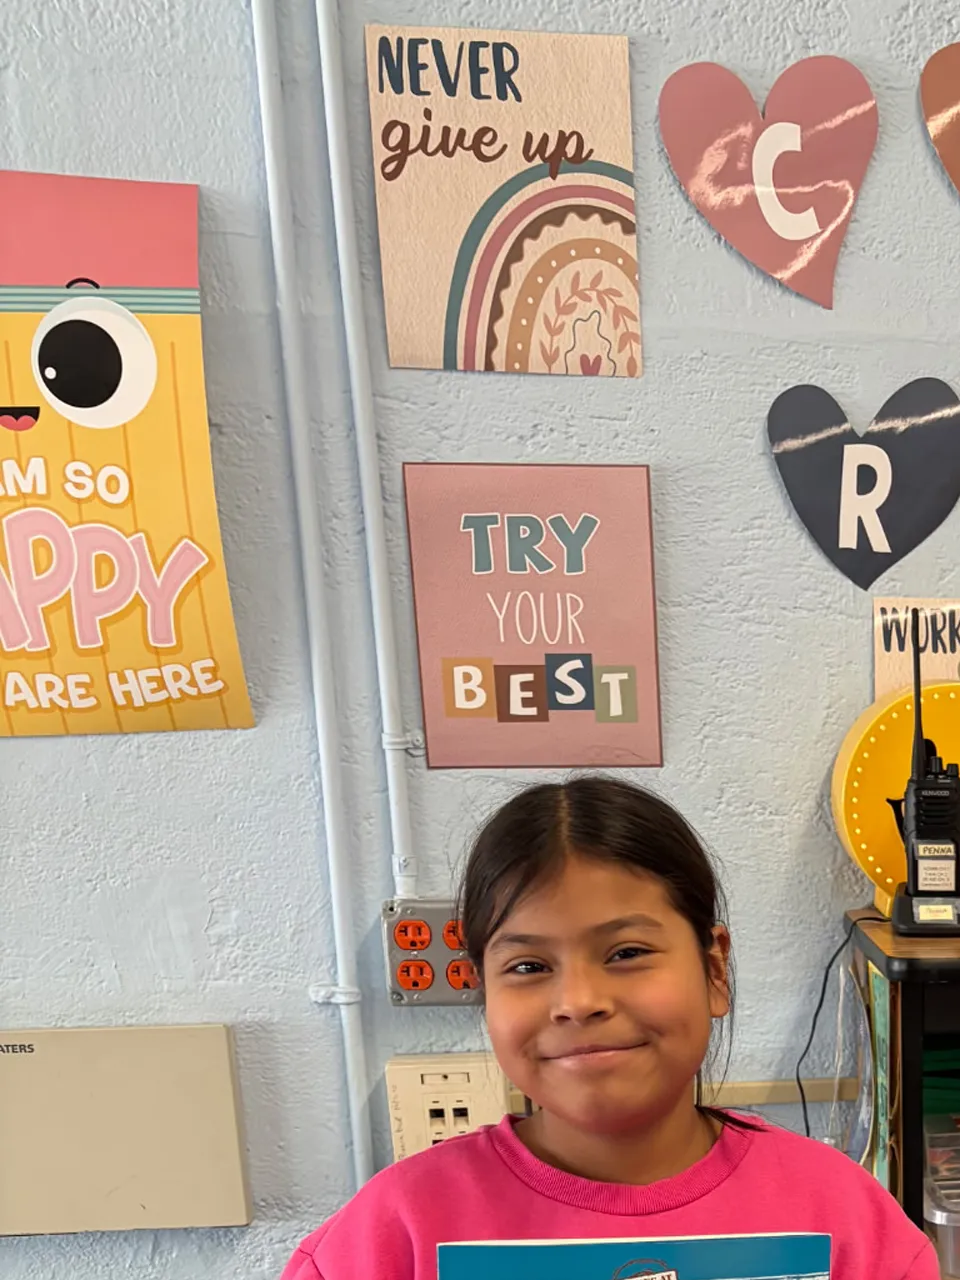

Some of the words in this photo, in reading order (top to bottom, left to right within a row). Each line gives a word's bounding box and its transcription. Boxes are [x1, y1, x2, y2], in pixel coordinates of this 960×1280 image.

[378, 36, 523, 103] NEVER
[381, 107, 508, 182] give
[522, 129, 594, 181] up
[0, 457, 48, 497] M
[63, 460, 130, 505] SO
[460, 512, 601, 576] TRY
[486, 590, 586, 645] YOUR
[5, 672, 97, 709] ARE
[108, 658, 224, 707] HERE
[453, 659, 630, 718] BEST
